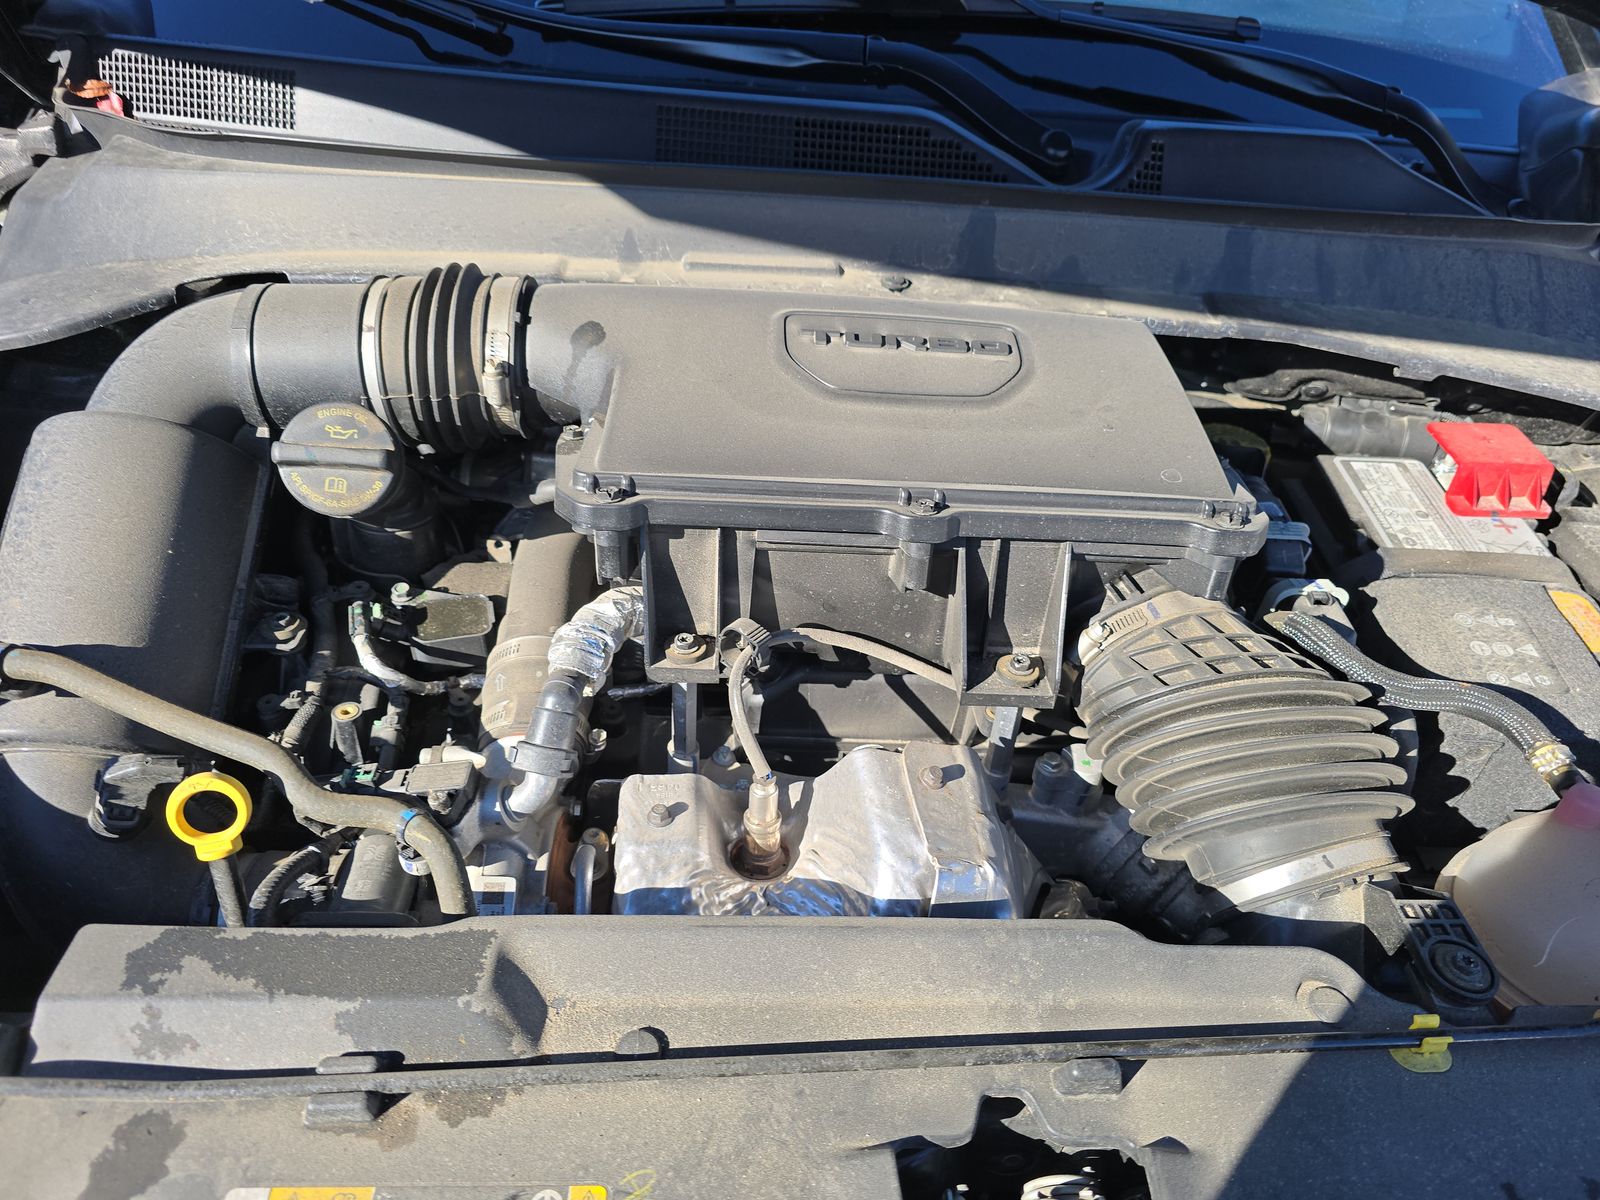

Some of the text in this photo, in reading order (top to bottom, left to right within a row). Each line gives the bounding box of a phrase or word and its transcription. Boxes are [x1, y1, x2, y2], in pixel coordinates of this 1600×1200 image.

[800, 328, 1013, 357] TURBO
[316, 408, 367, 424] ENGINE OIL
